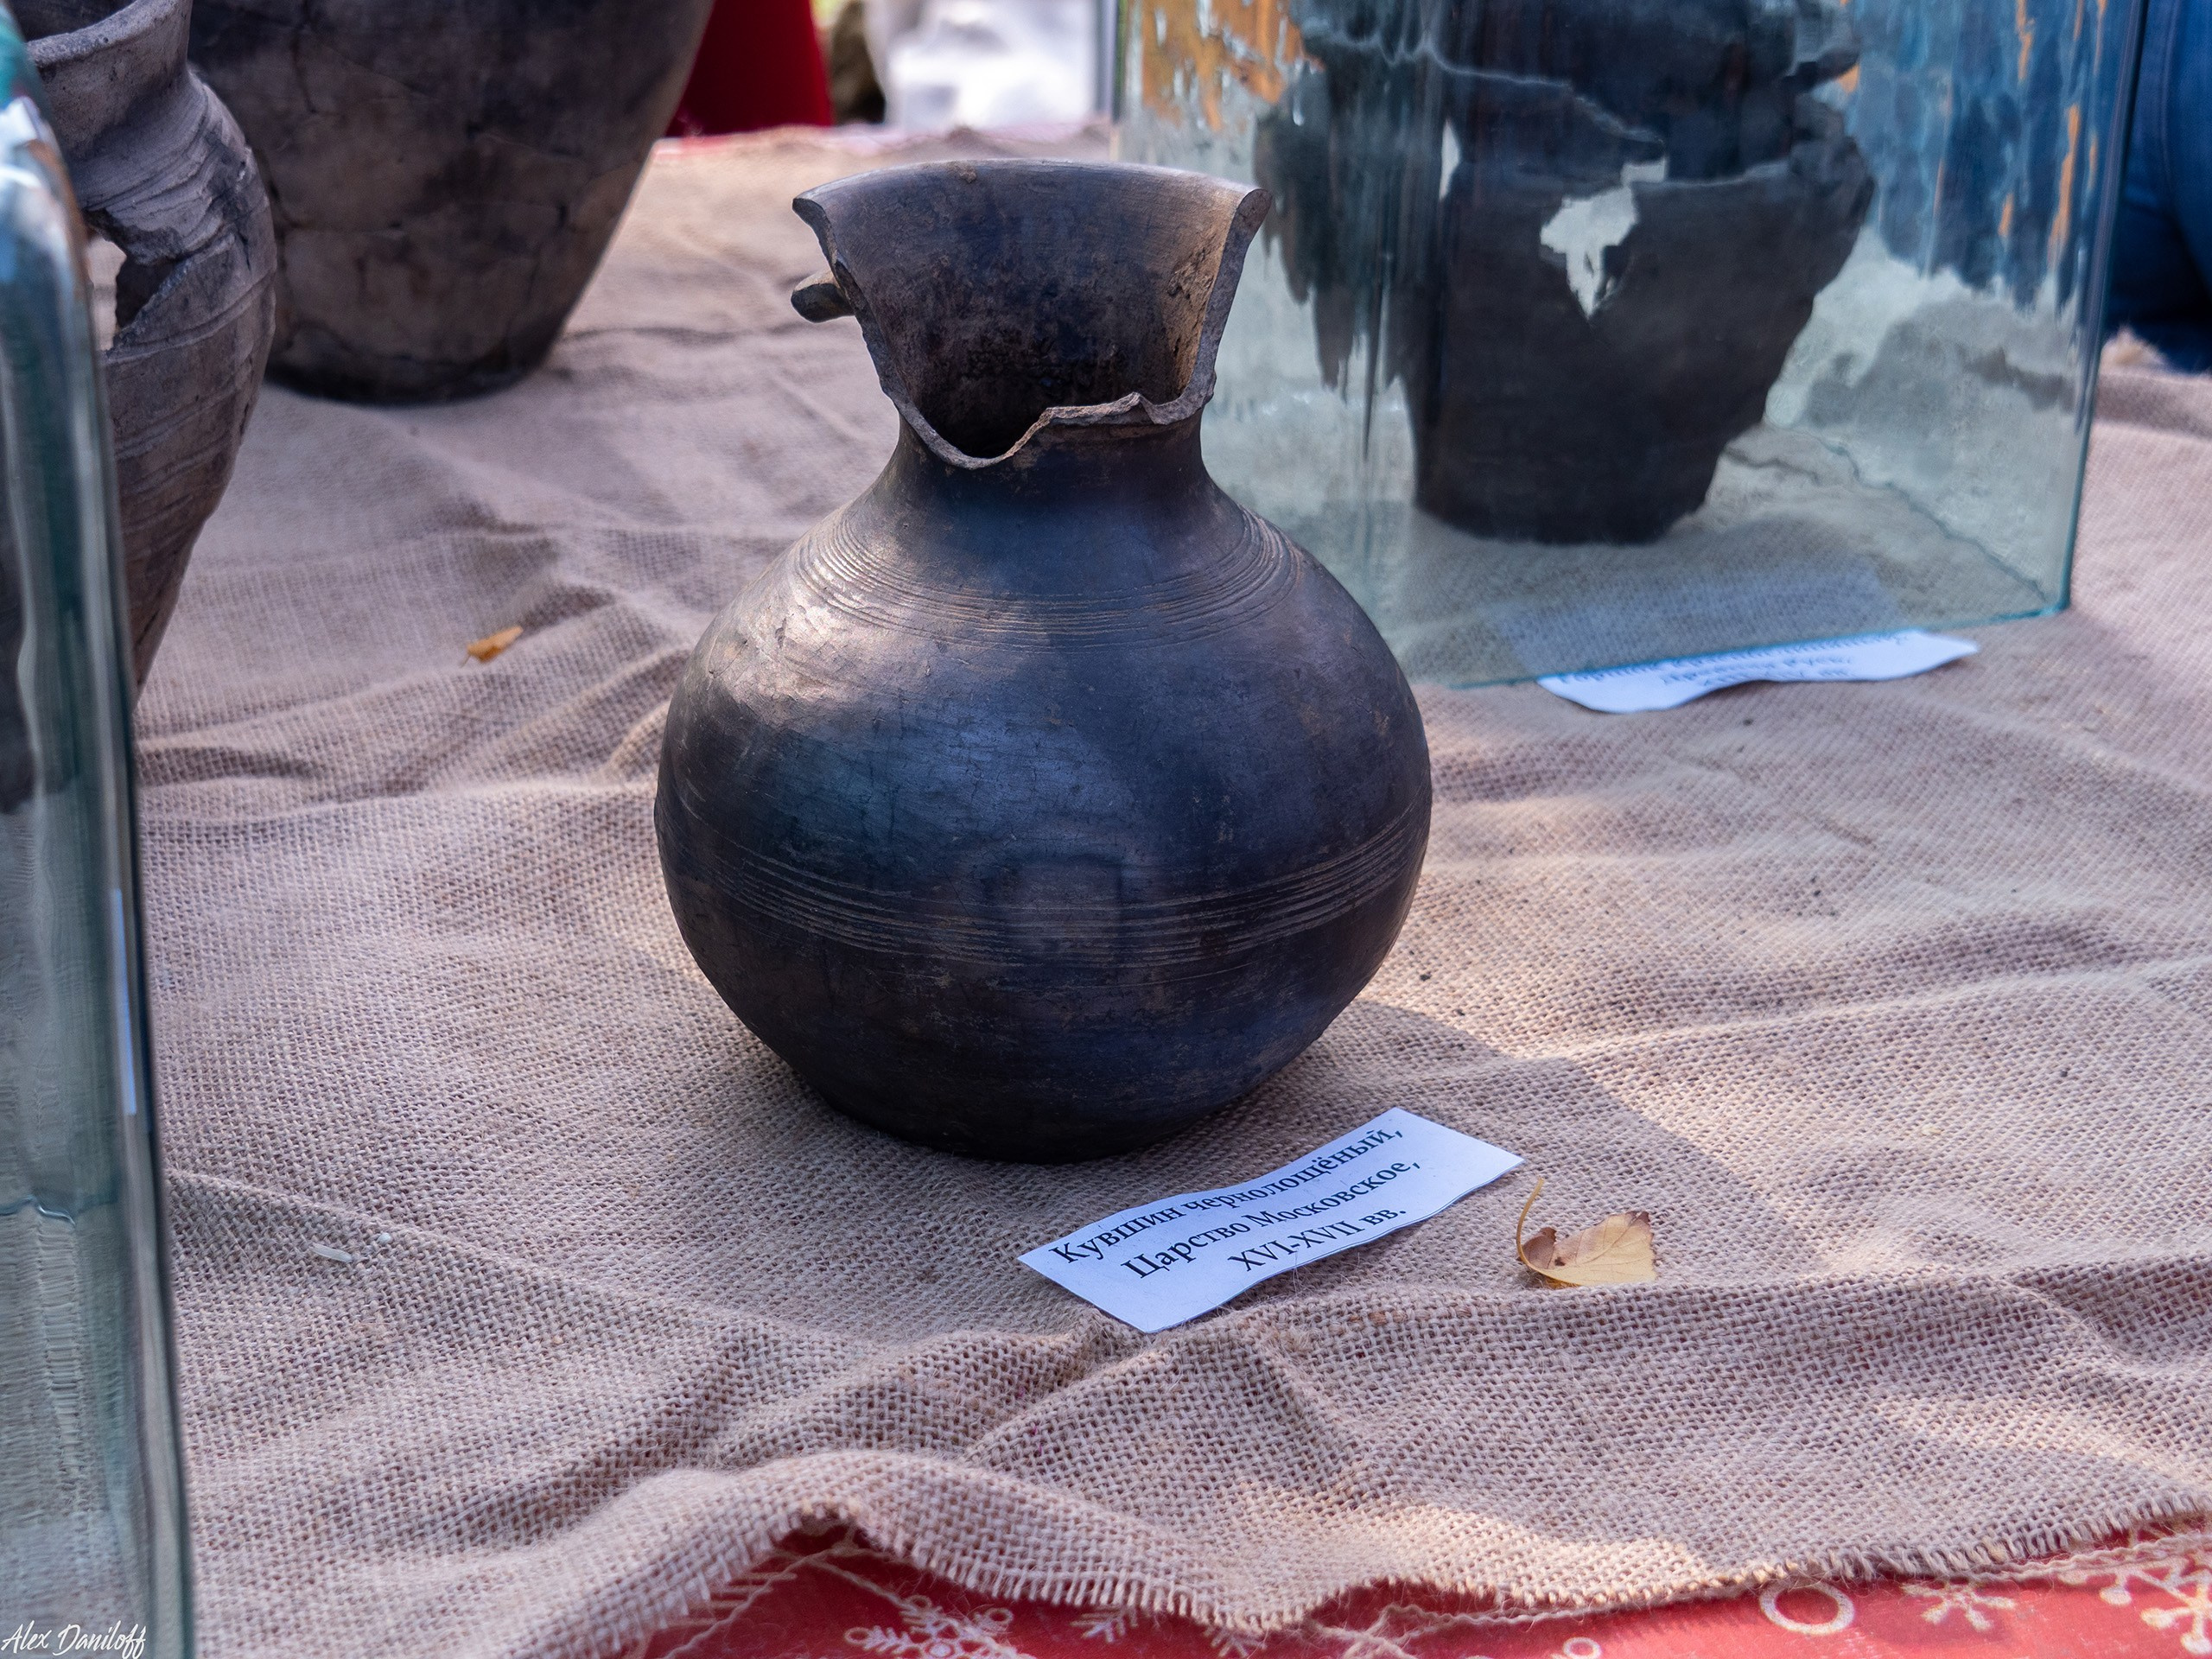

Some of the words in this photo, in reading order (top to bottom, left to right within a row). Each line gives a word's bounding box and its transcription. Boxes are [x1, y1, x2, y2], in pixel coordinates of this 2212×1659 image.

[1048, 1207, 1187, 1264] Кувшин
[1180, 1129, 1403, 1211] чернолощёный,
[1120, 1222, 1251, 1279] Царство
[1241, 1160, 1421, 1228] Московское,
[1227, 1220, 1366, 1273] XVI-XVII
[1358, 1208, 1408, 1227] вв.
